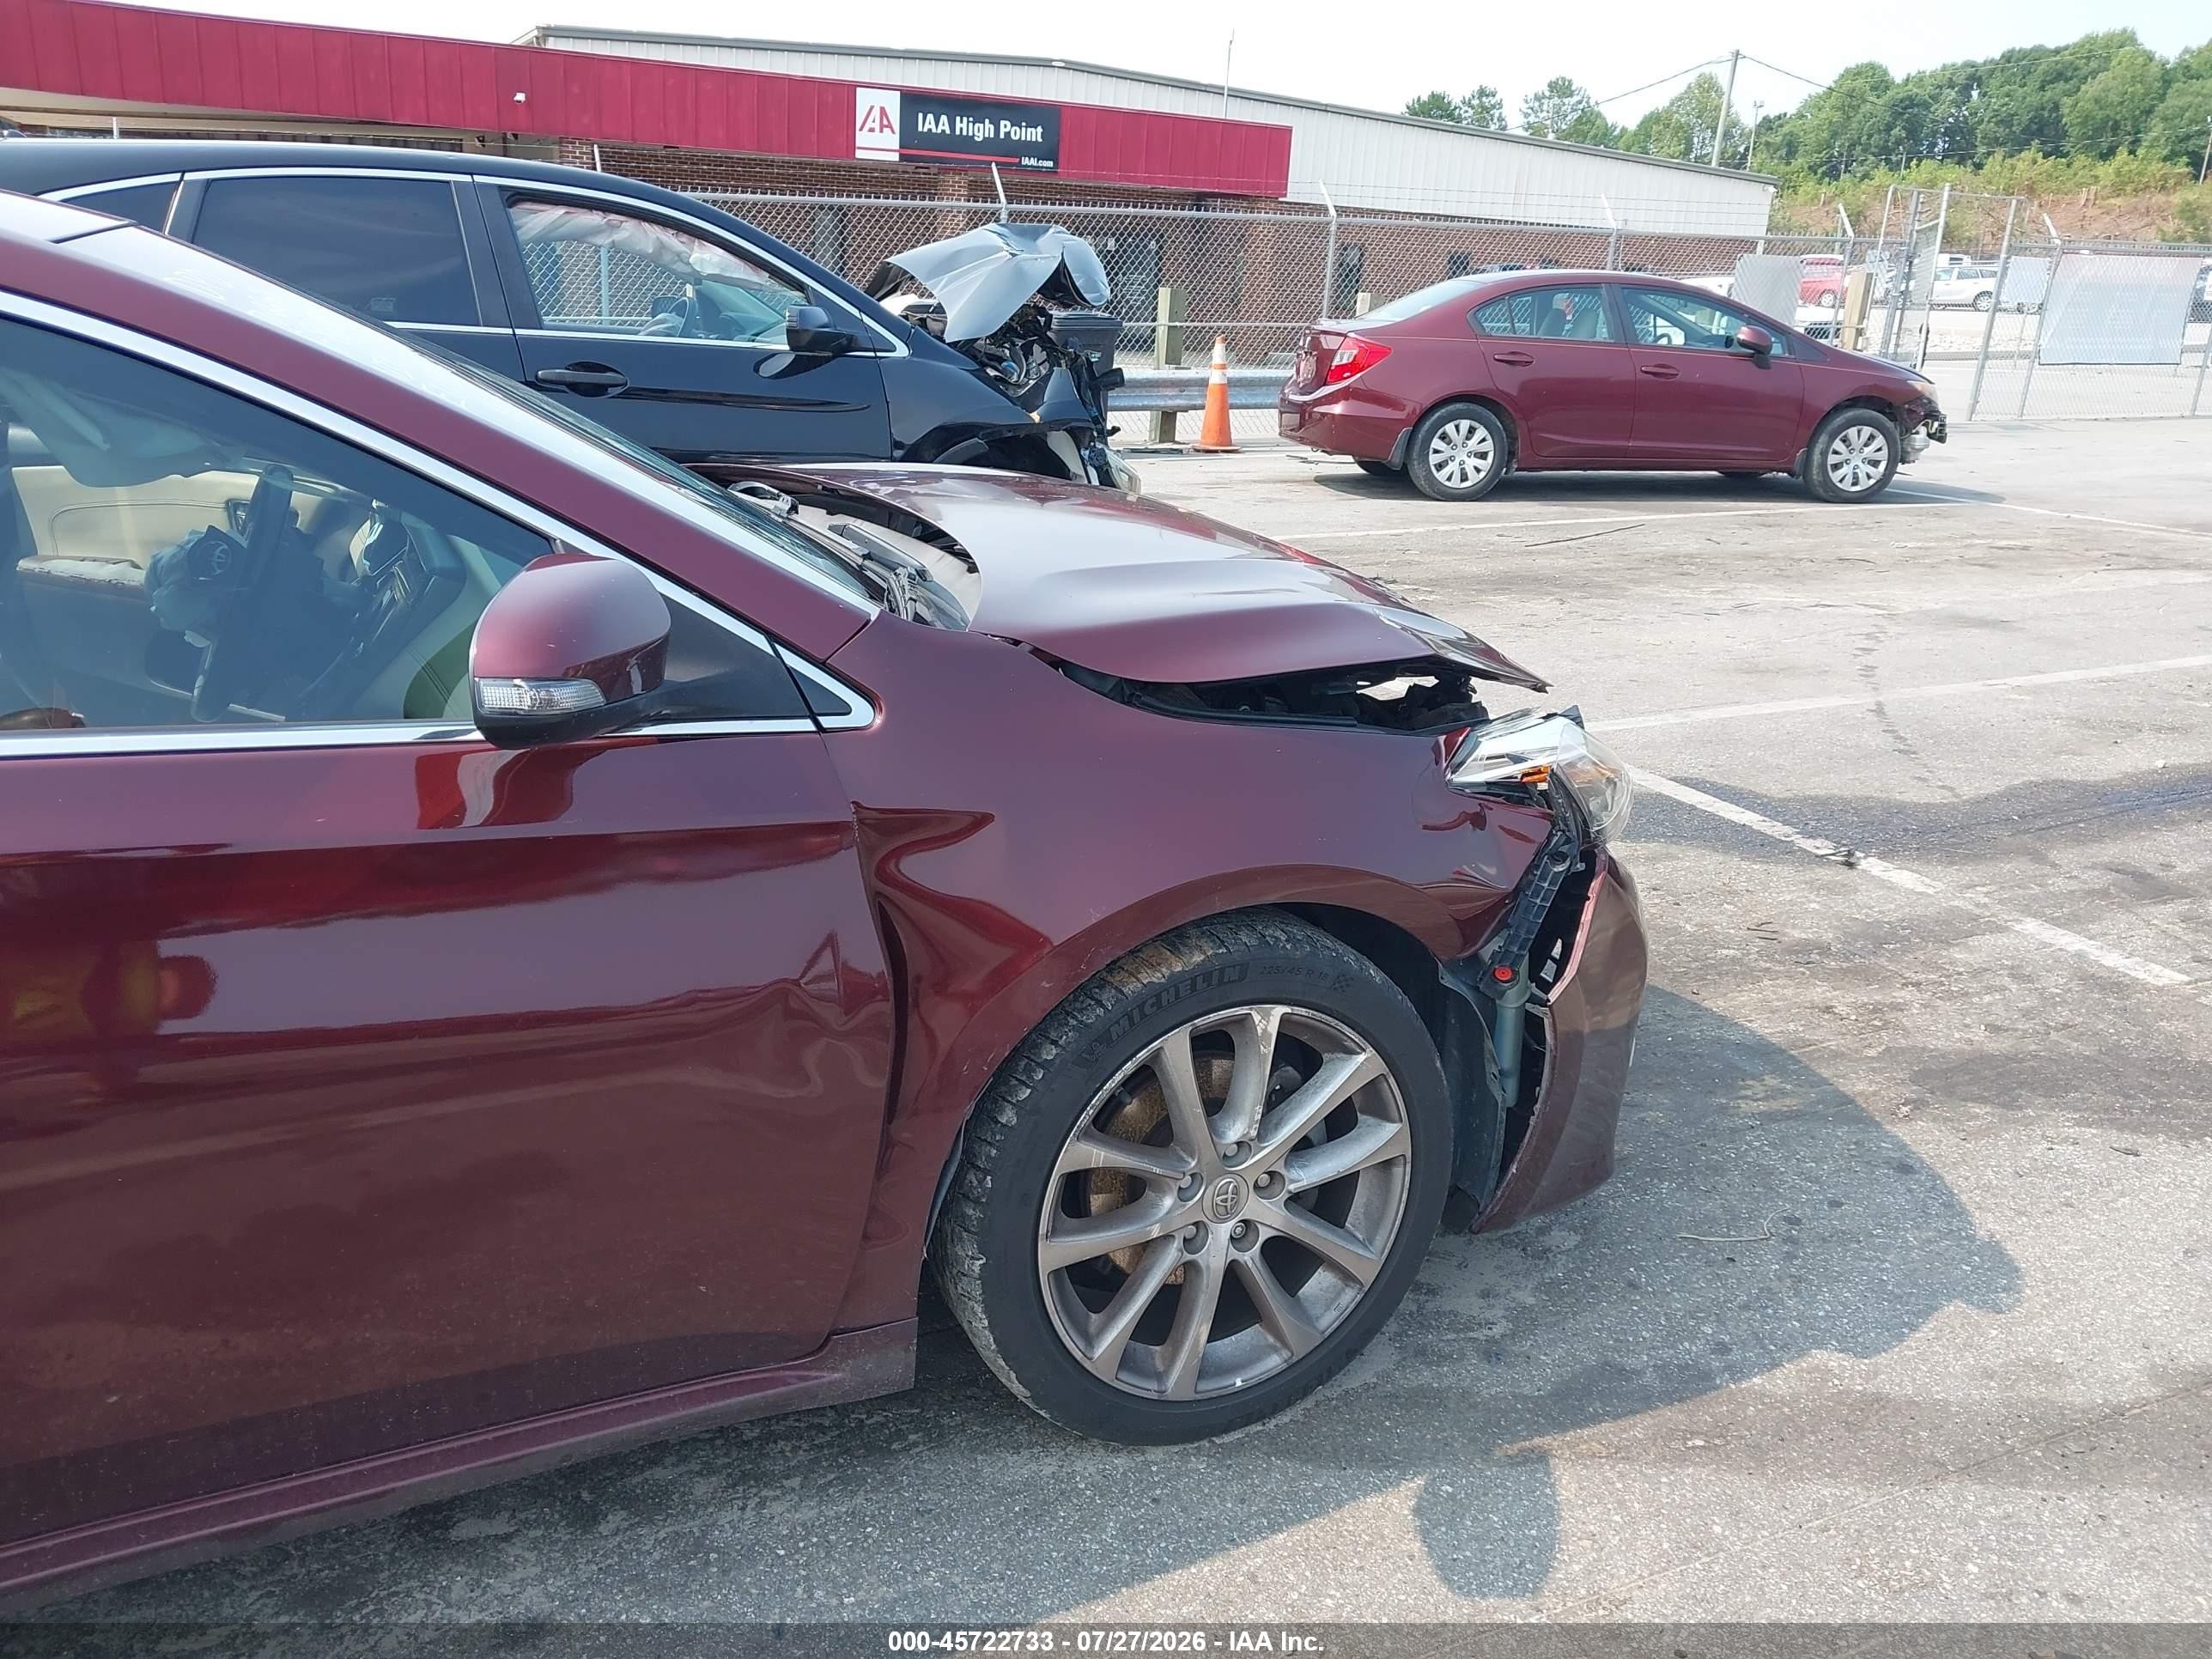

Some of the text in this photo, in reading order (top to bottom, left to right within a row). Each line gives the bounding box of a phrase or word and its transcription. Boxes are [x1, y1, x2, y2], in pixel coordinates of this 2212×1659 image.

[917, 112, 1043, 143] IAA High Point
[1021, 156, 1054, 167] IAAI.com
[1109, 965, 1240, 1040] MICHELIN
